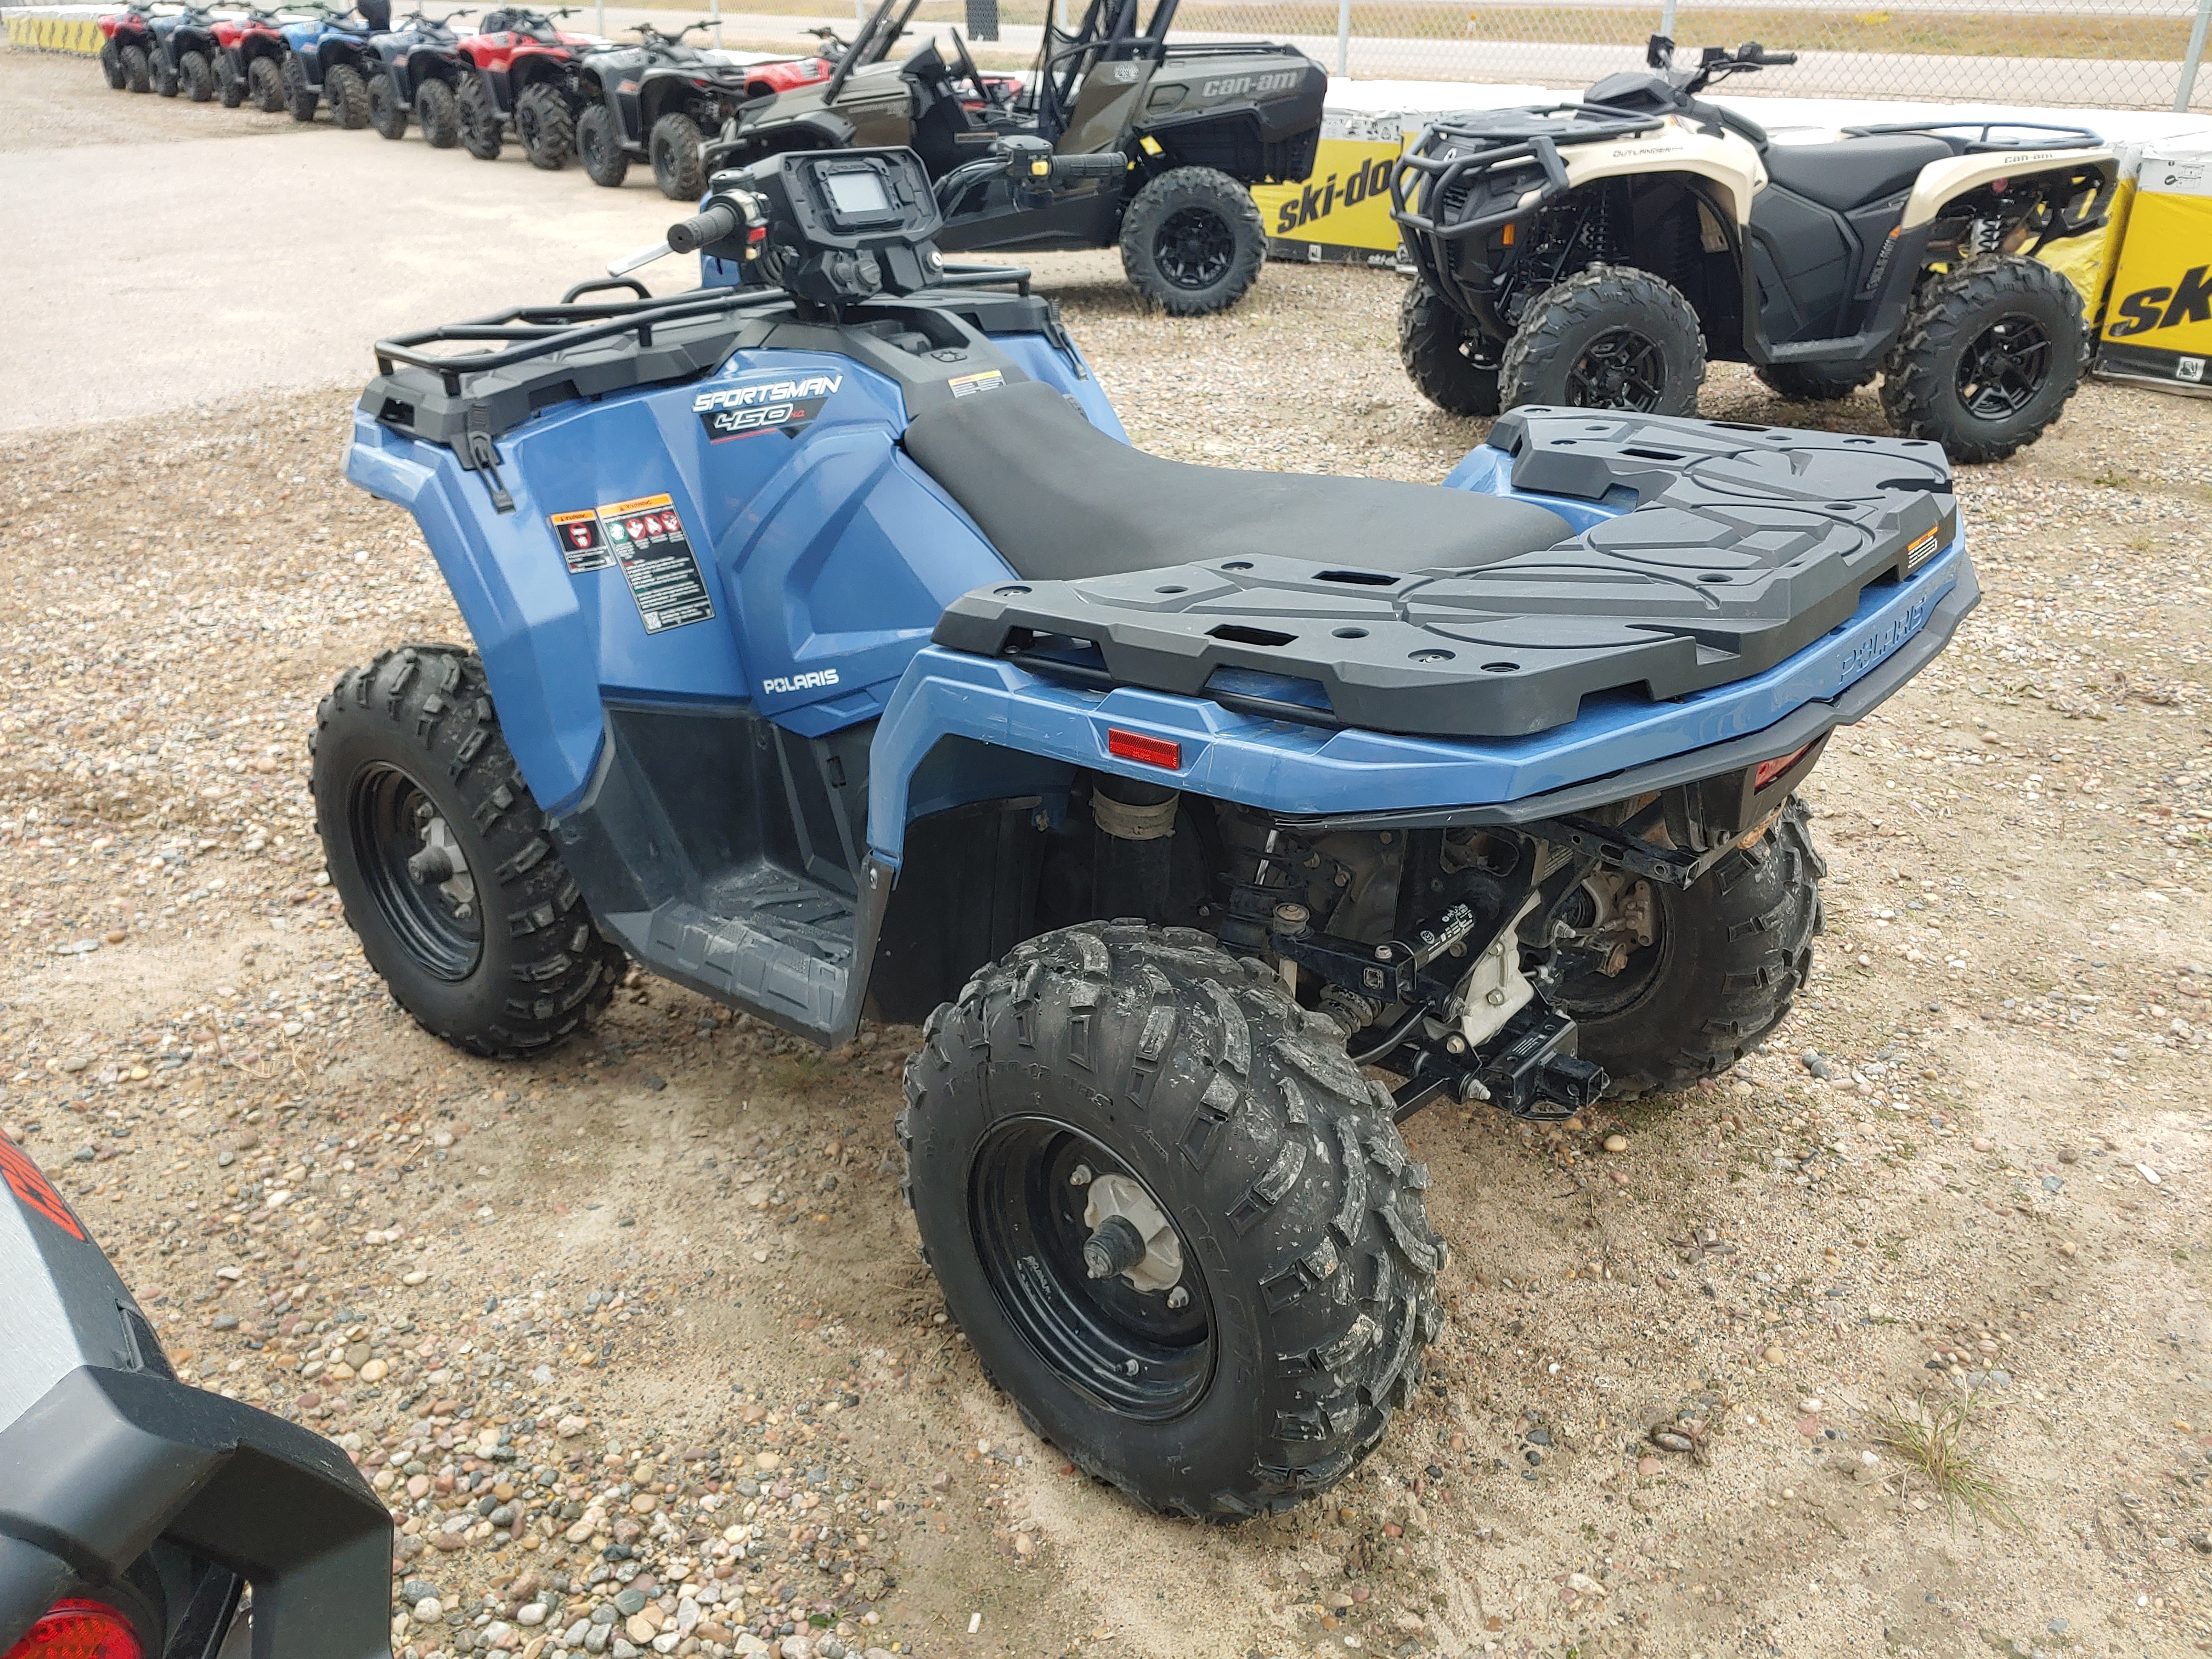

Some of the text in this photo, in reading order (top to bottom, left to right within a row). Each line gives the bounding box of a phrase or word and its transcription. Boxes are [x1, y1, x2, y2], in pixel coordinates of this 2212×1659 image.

[1201, 71, 1299, 98] can-am
[1612, 147, 1671, 158] OUTLANDER
[2004, 153, 2053, 163] can-am
[1277, 156, 1401, 234] ski-do
[692, 375, 843, 412] SPORTSMAN
[713, 403, 794, 432] 450
[1840, 596, 1928, 682] POLARIS
[763, 668, 839, 695] POLARIS
